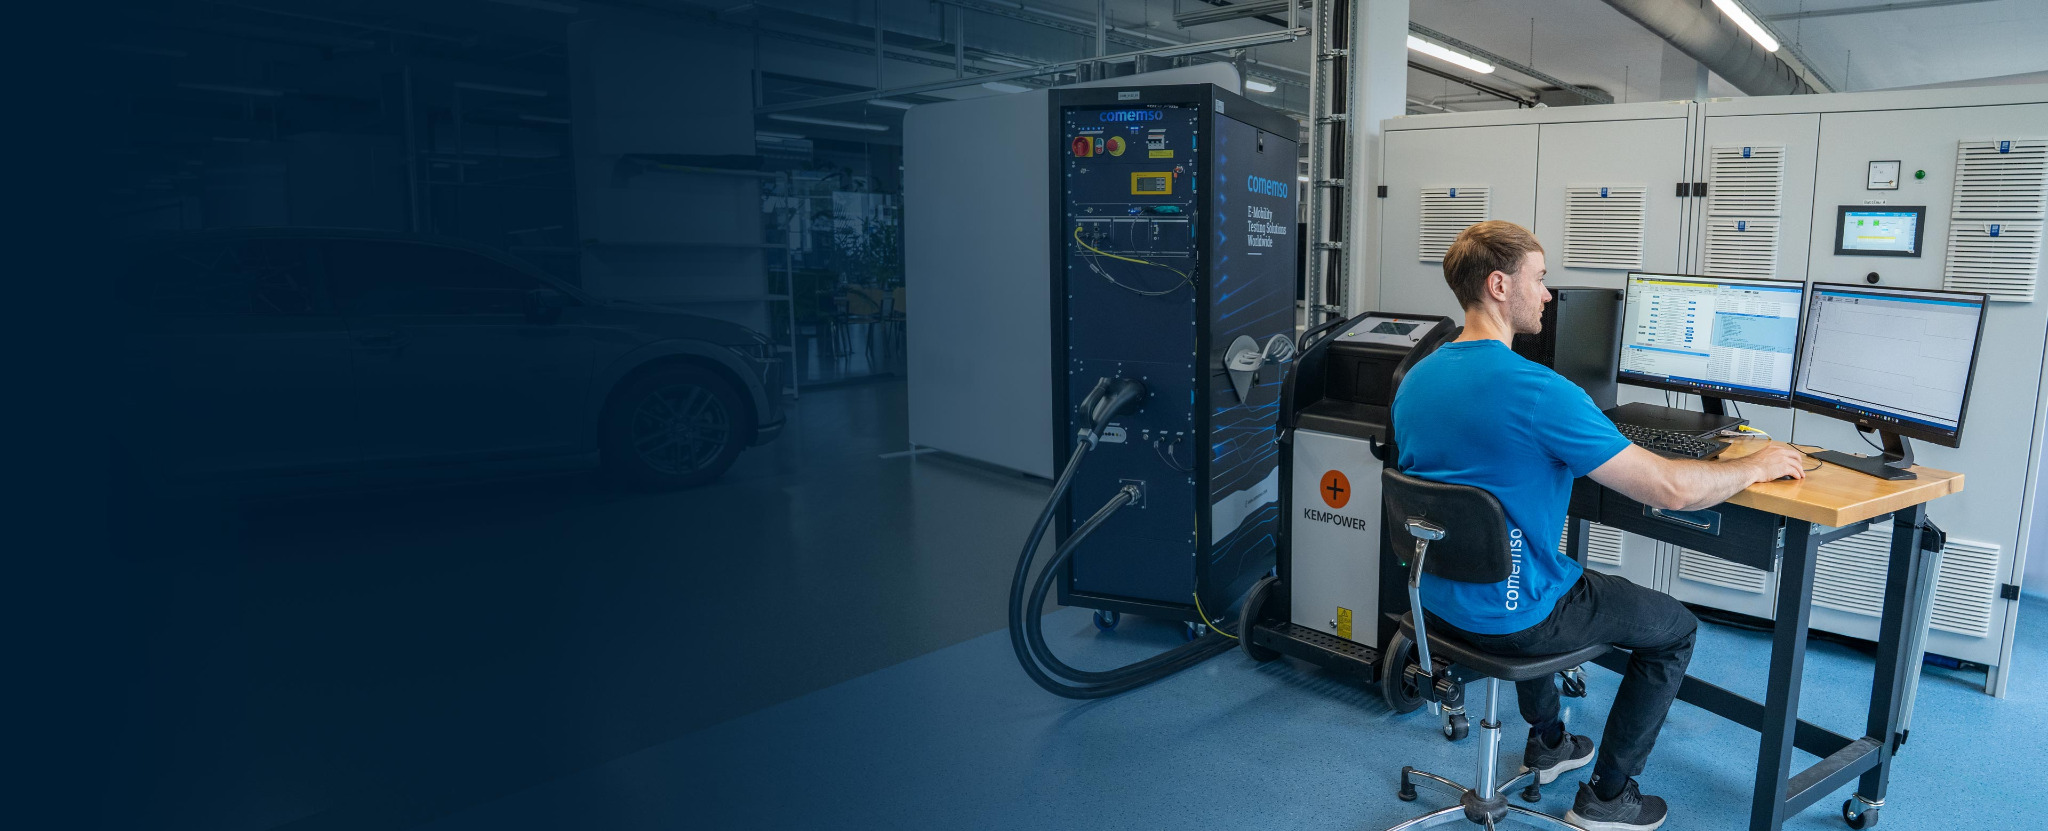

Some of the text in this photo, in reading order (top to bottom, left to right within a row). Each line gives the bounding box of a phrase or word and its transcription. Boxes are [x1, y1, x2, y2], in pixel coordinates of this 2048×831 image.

[1100, 110, 1163, 122] comemso
[1247, 174, 1288, 199] comemso
[1247, 205, 1273, 222] E-Mobility
[1247, 220, 1287, 236] Testing Solutions
[1247, 234, 1273, 248] Worldwide
[1304, 507, 1366, 531] KEMPOWER
